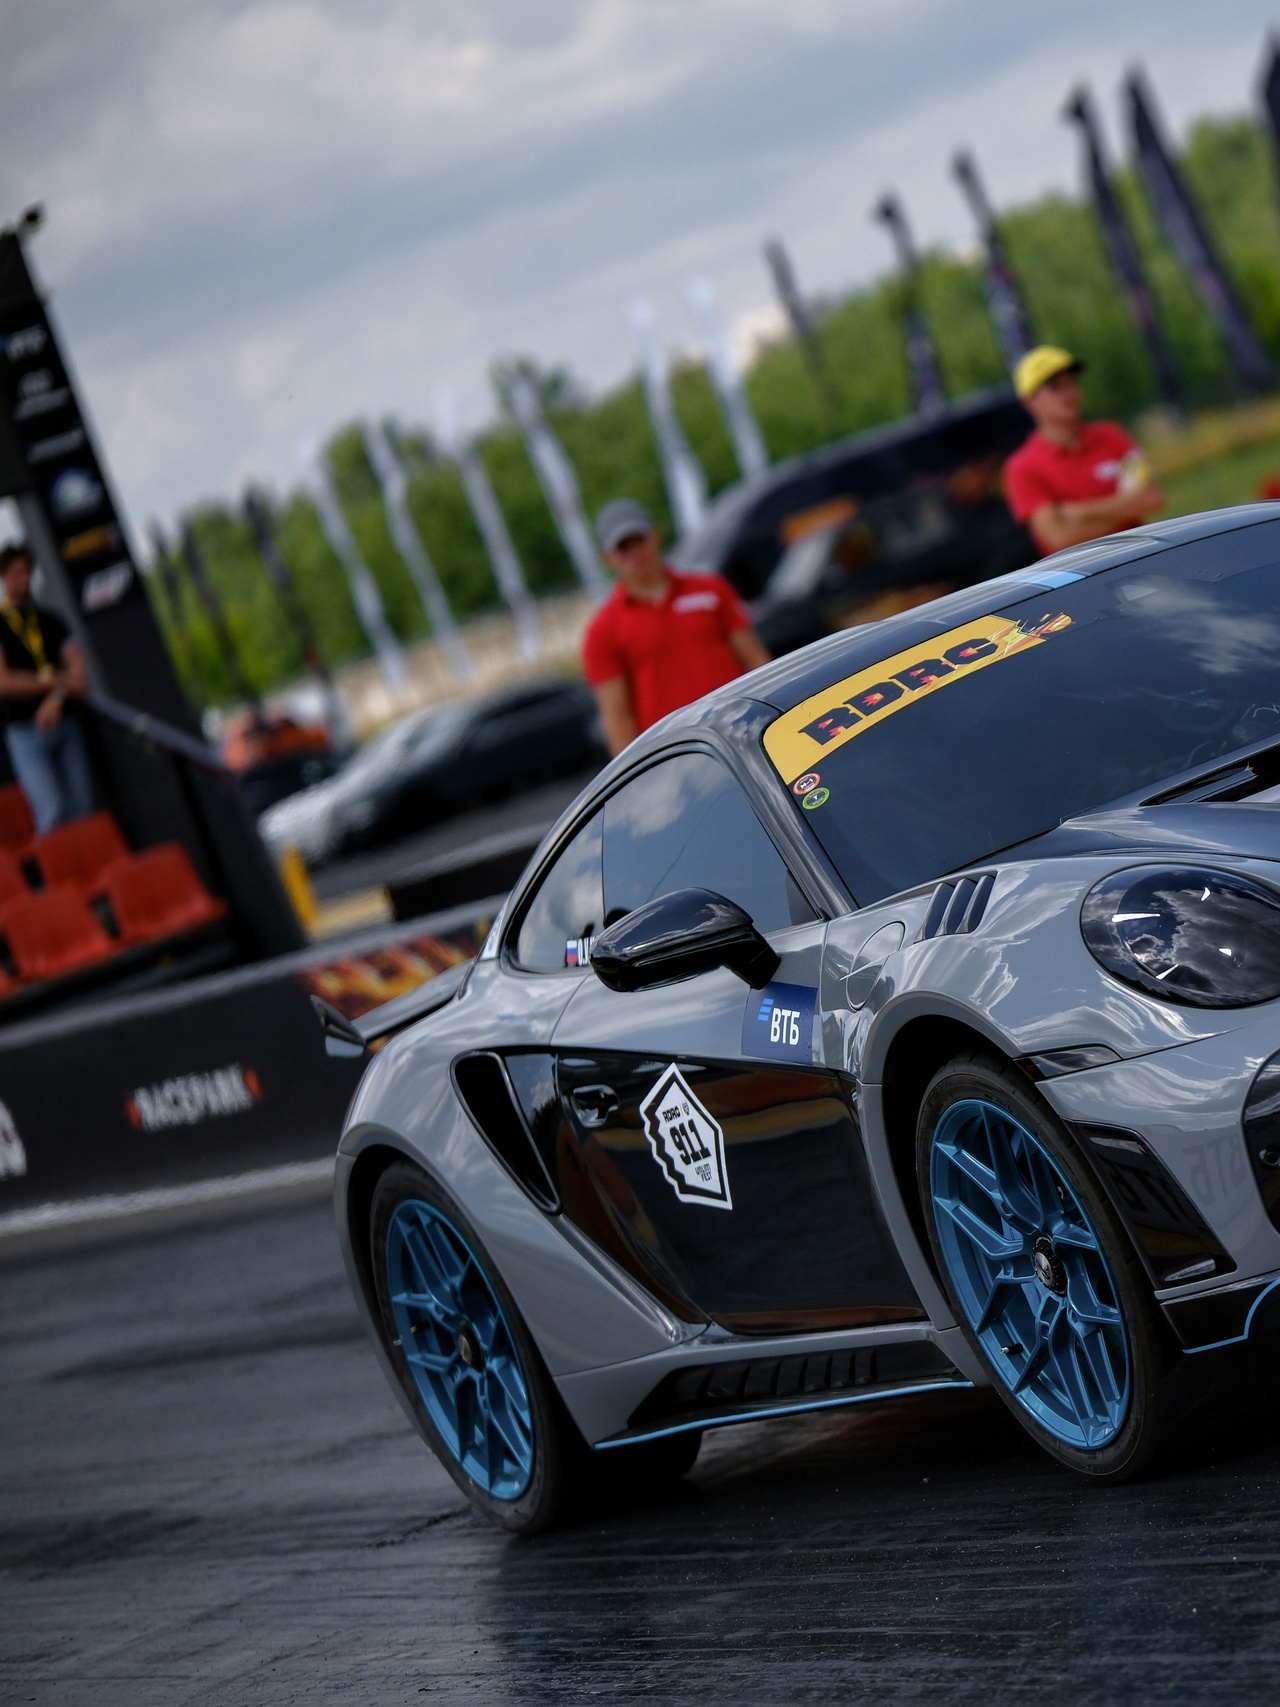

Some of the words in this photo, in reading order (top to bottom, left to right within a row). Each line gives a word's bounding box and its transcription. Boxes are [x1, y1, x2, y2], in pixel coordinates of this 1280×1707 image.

[797, 637, 1000, 746] RDRC
[770, 1007, 801, 1046] ВТБ
[661, 1105, 681, 1123] RDRC
[669, 1118, 712, 1166] 911
[700, 1171, 713, 1183] FEST
